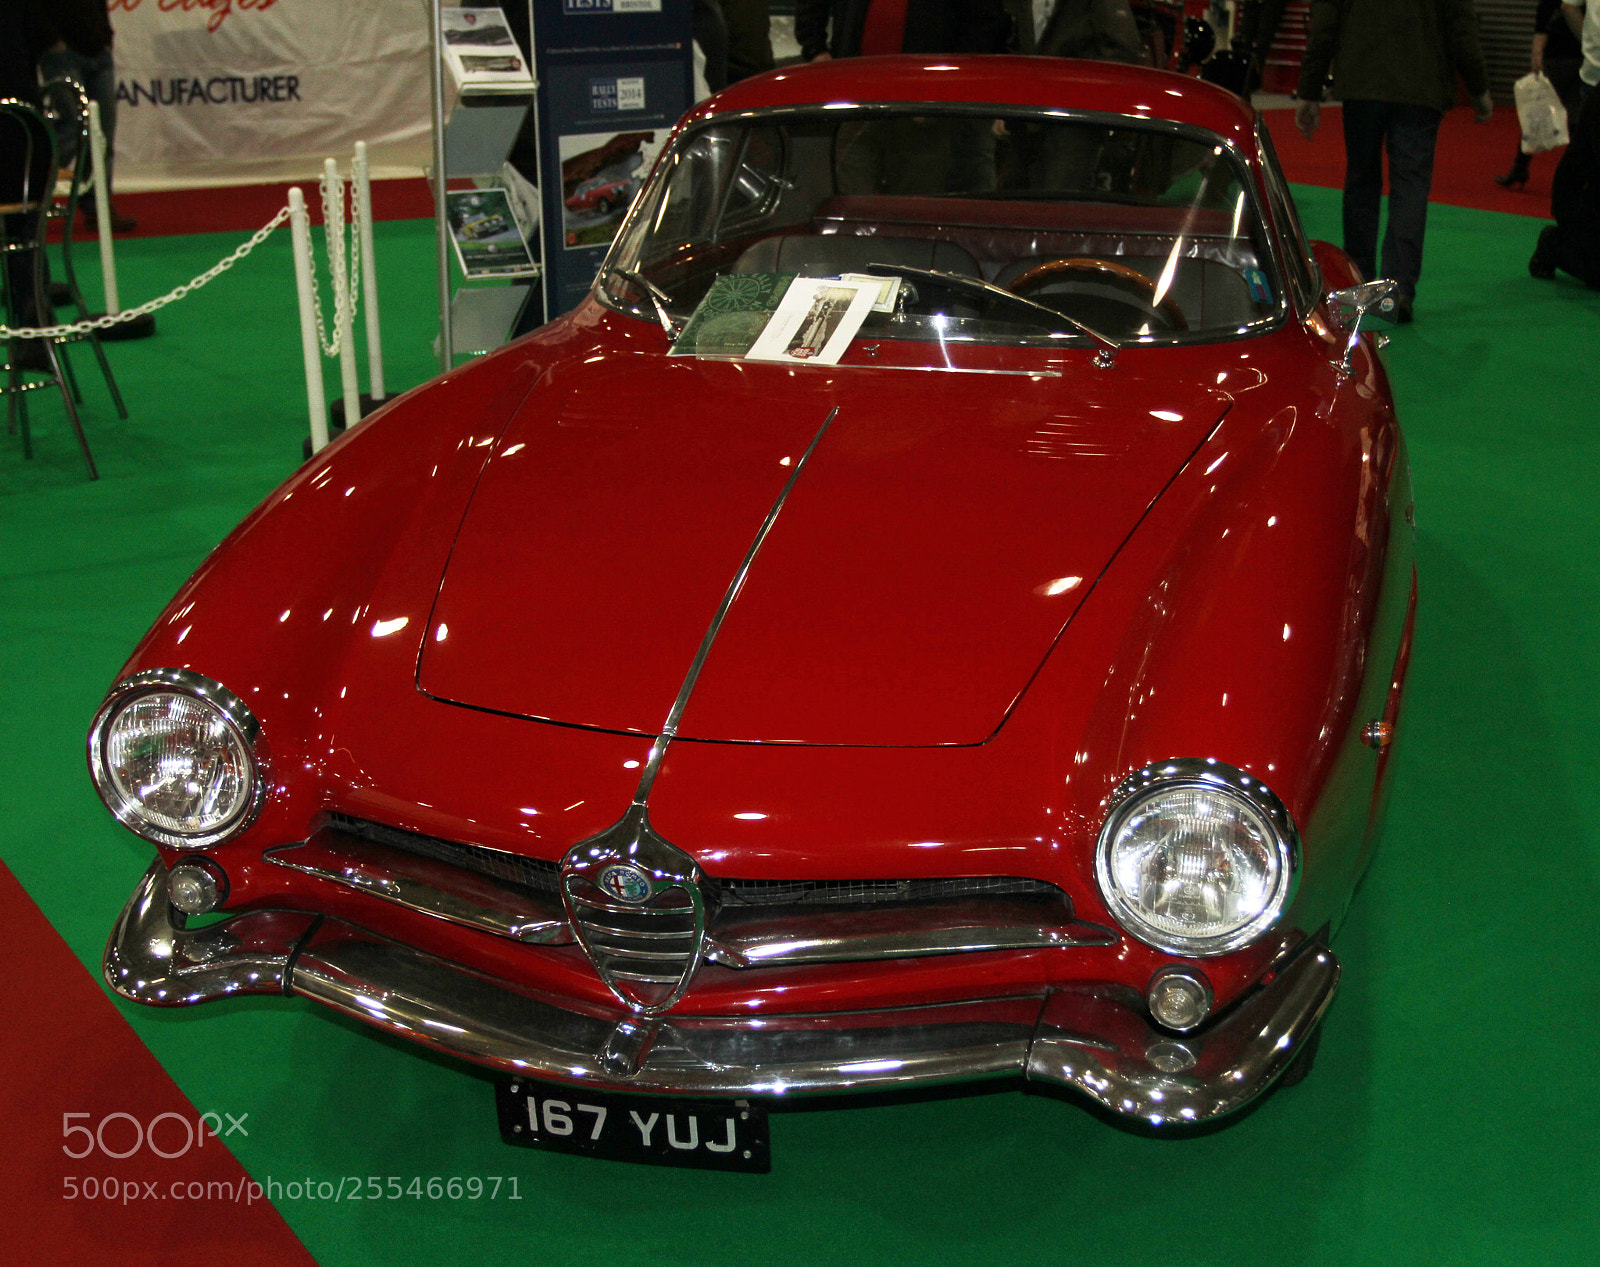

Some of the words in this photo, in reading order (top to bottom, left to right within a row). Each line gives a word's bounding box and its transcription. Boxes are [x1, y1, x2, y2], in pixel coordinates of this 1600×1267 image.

[115, 74, 300, 107] ANUFACTURER
[527, 1096, 607, 1140] 167
[629, 1110, 736, 1153] YUJ
